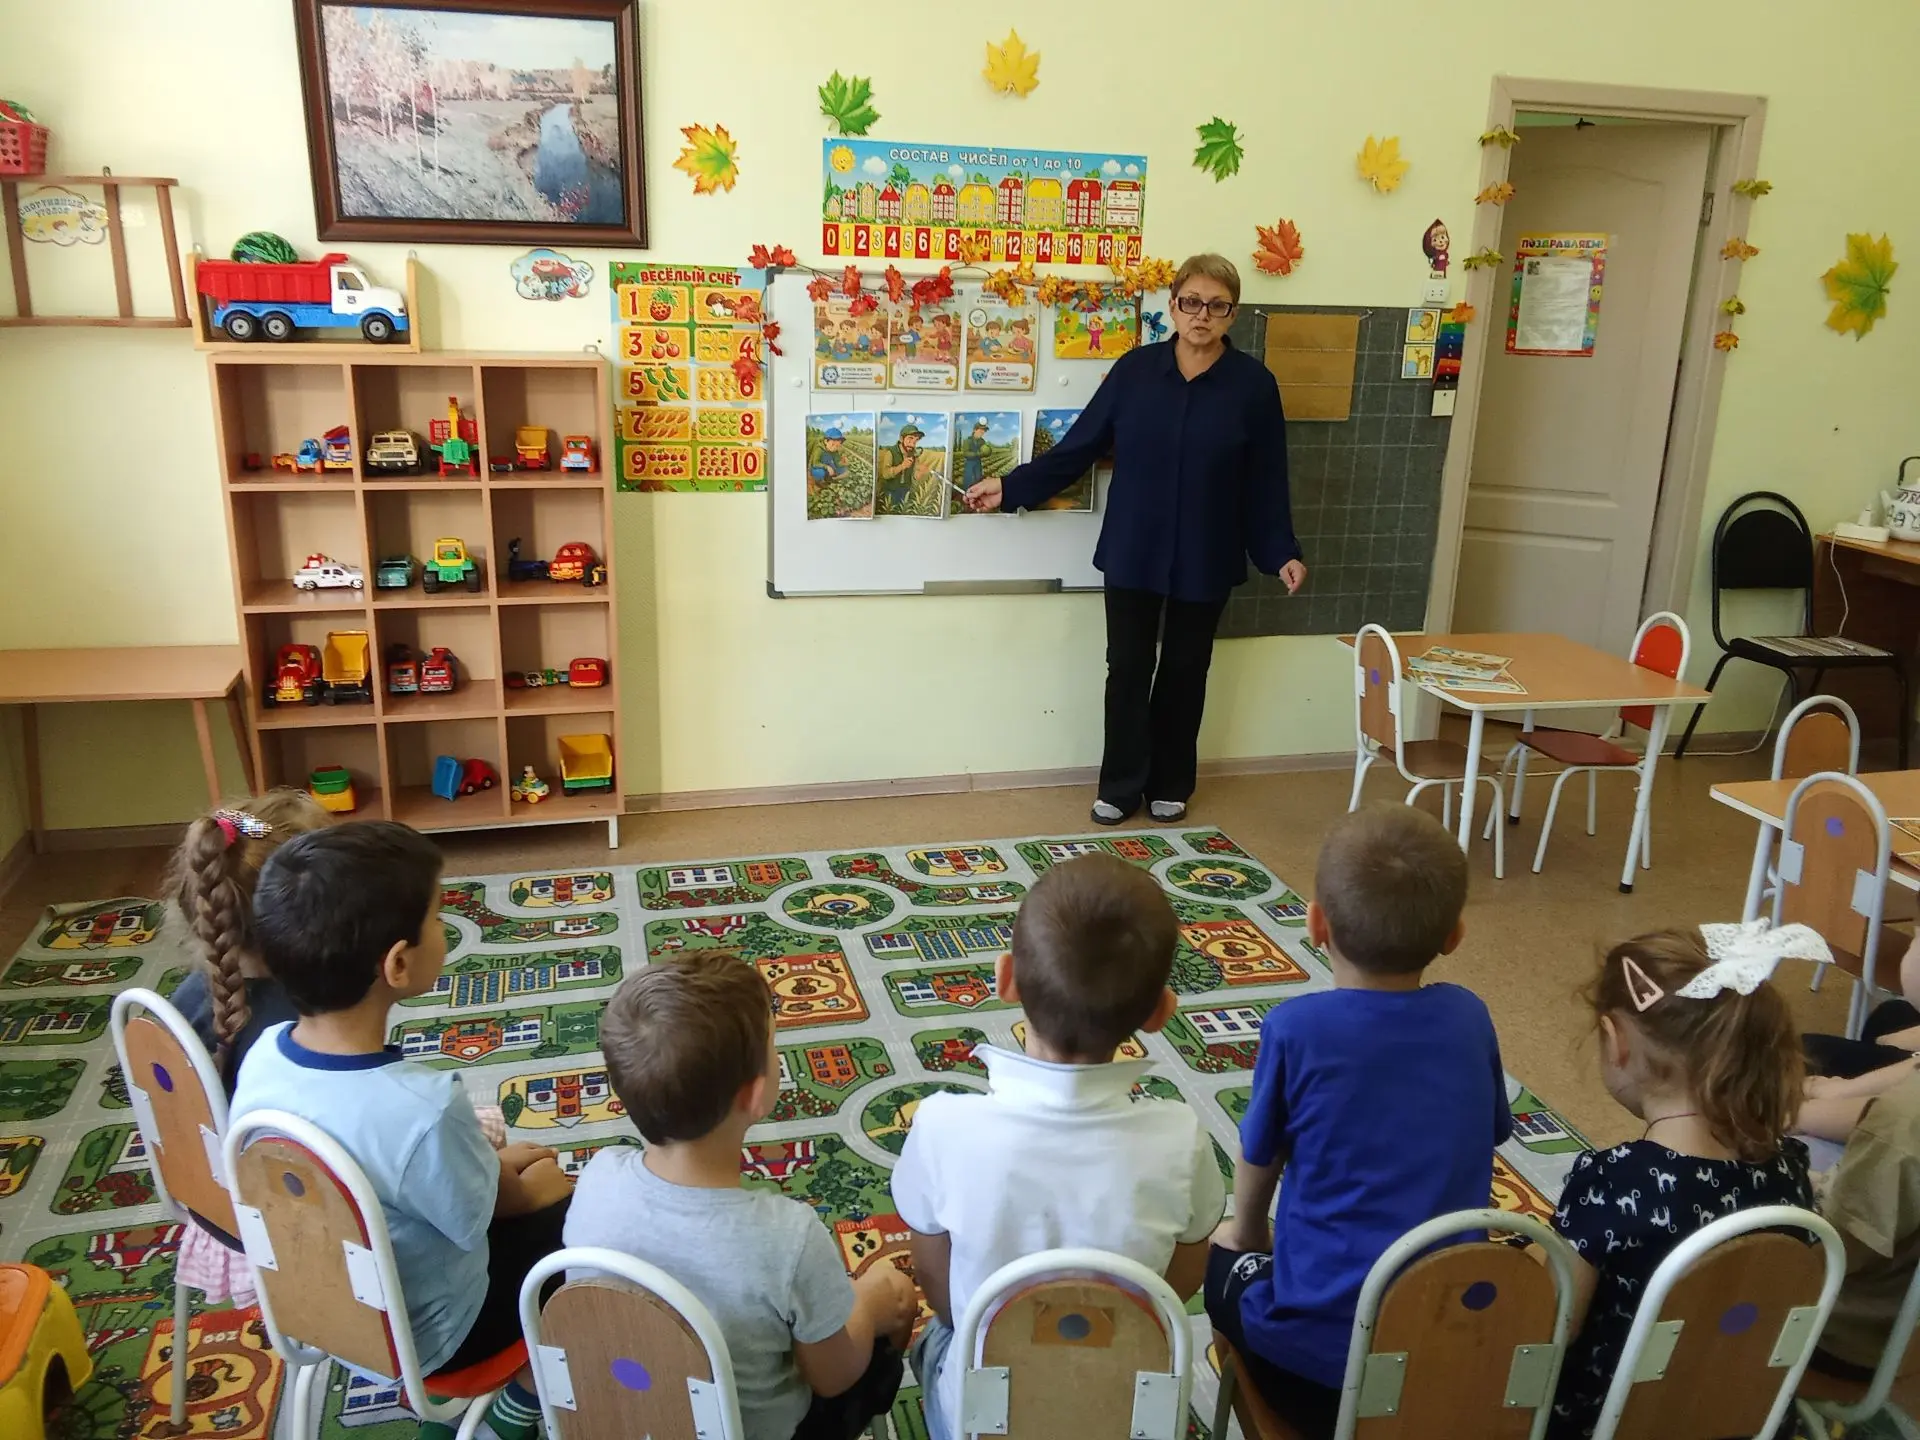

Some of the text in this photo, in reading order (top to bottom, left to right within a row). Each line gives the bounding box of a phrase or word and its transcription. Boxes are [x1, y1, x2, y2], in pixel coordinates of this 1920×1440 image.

[889, 149, 1081, 170] СОСТАВ ЧИСЕЛ от 1 до 10
[826, 228, 836, 248] 0
[843, 229, 850, 249] 1
[857, 230, 867, 250] 2
[873, 231, 882, 250] 3
[887, 231, 898, 250] 4
[904, 232, 912, 251] 5
[918, 232, 928, 251] 6
[934, 233, 943, 252] 7
[948, 233, 957, 252] 8
[993, 235, 1004, 254] 11
[1007, 236, 1020, 255] 12
[1023, 237, 1035, 255] 13
[1038, 237, 1050, 256] 14
[1053, 238, 1065, 256] 15
[1068, 238, 1081, 257] 16
[1083, 239, 1096, 257] 17
[1099, 239, 1111, 258] 18
[1113, 240, 1125, 259] 19
[1128, 240, 1140, 259] 20
[640, 266, 742, 286] ВЕСЁЛЫЙ СЧЁТ
[629, 292, 638, 315] 1
[629, 333, 642, 356] 3
[739, 336, 753, 359] 4
[629, 372, 644, 395] 5
[740, 375, 754, 397] 6
[631, 411, 644, 434] 7
[740, 413, 754, 435] 8
[632, 451, 646, 474] 9
[731, 451, 757, 474] 10
